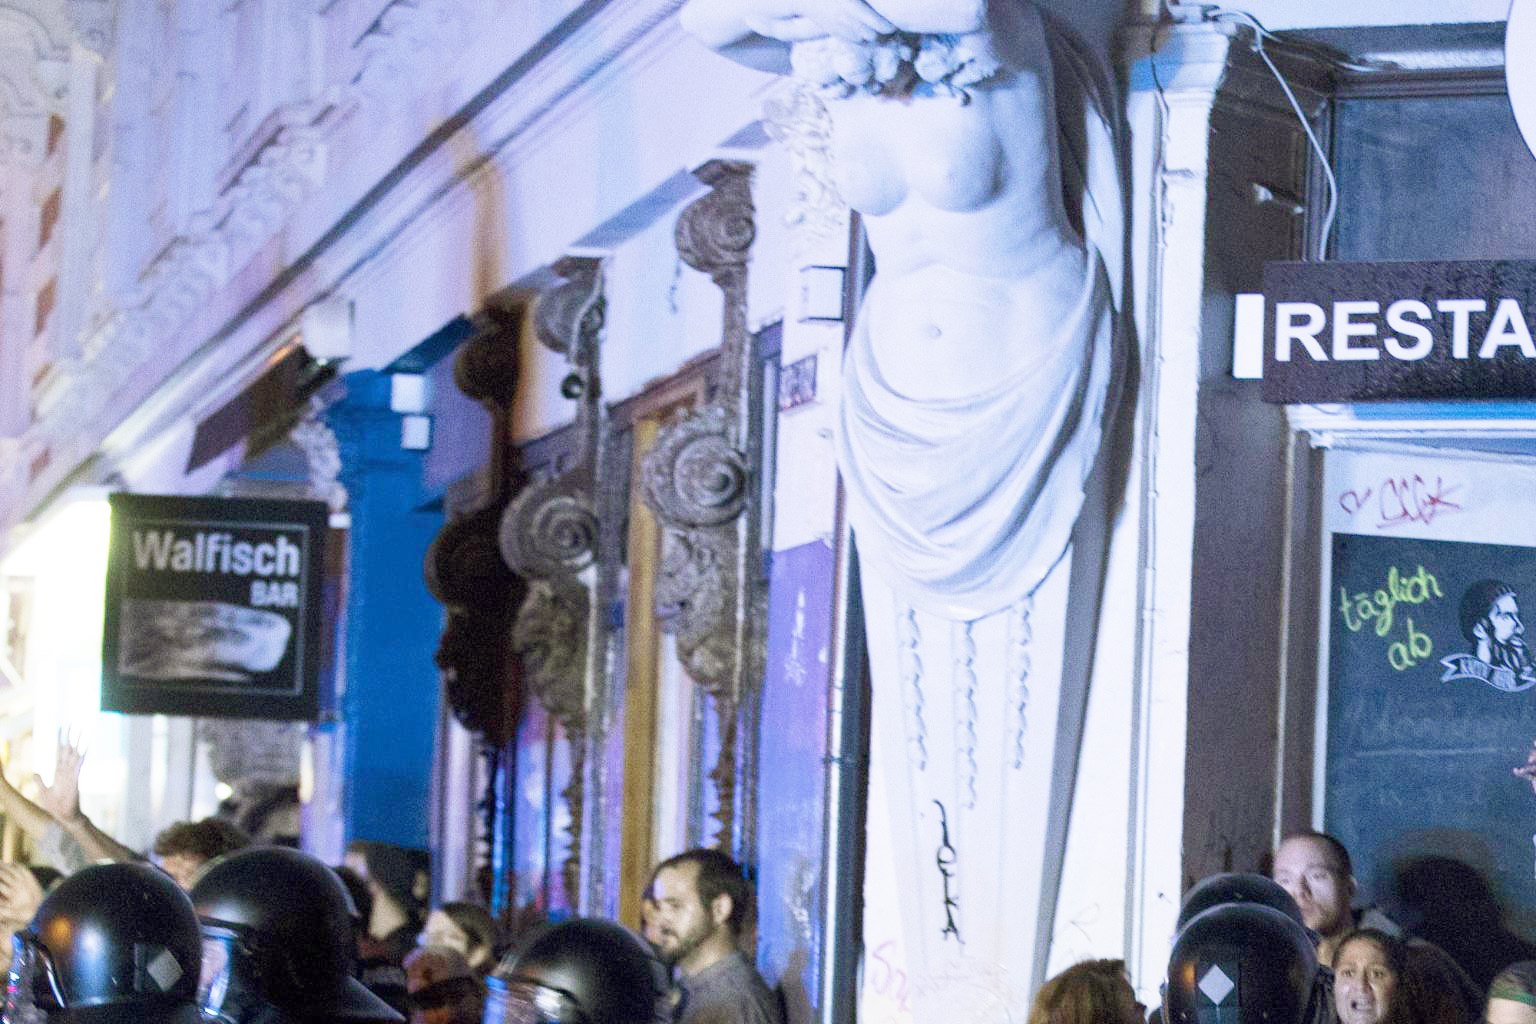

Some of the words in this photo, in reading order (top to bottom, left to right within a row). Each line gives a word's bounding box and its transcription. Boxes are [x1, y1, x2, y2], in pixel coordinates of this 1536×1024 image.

[132, 529, 301, 577] Walfisch
[250, 579, 300, 607] BAR
[1340, 565, 1443, 637] täglich
[1387, 617, 1433, 671] ab
